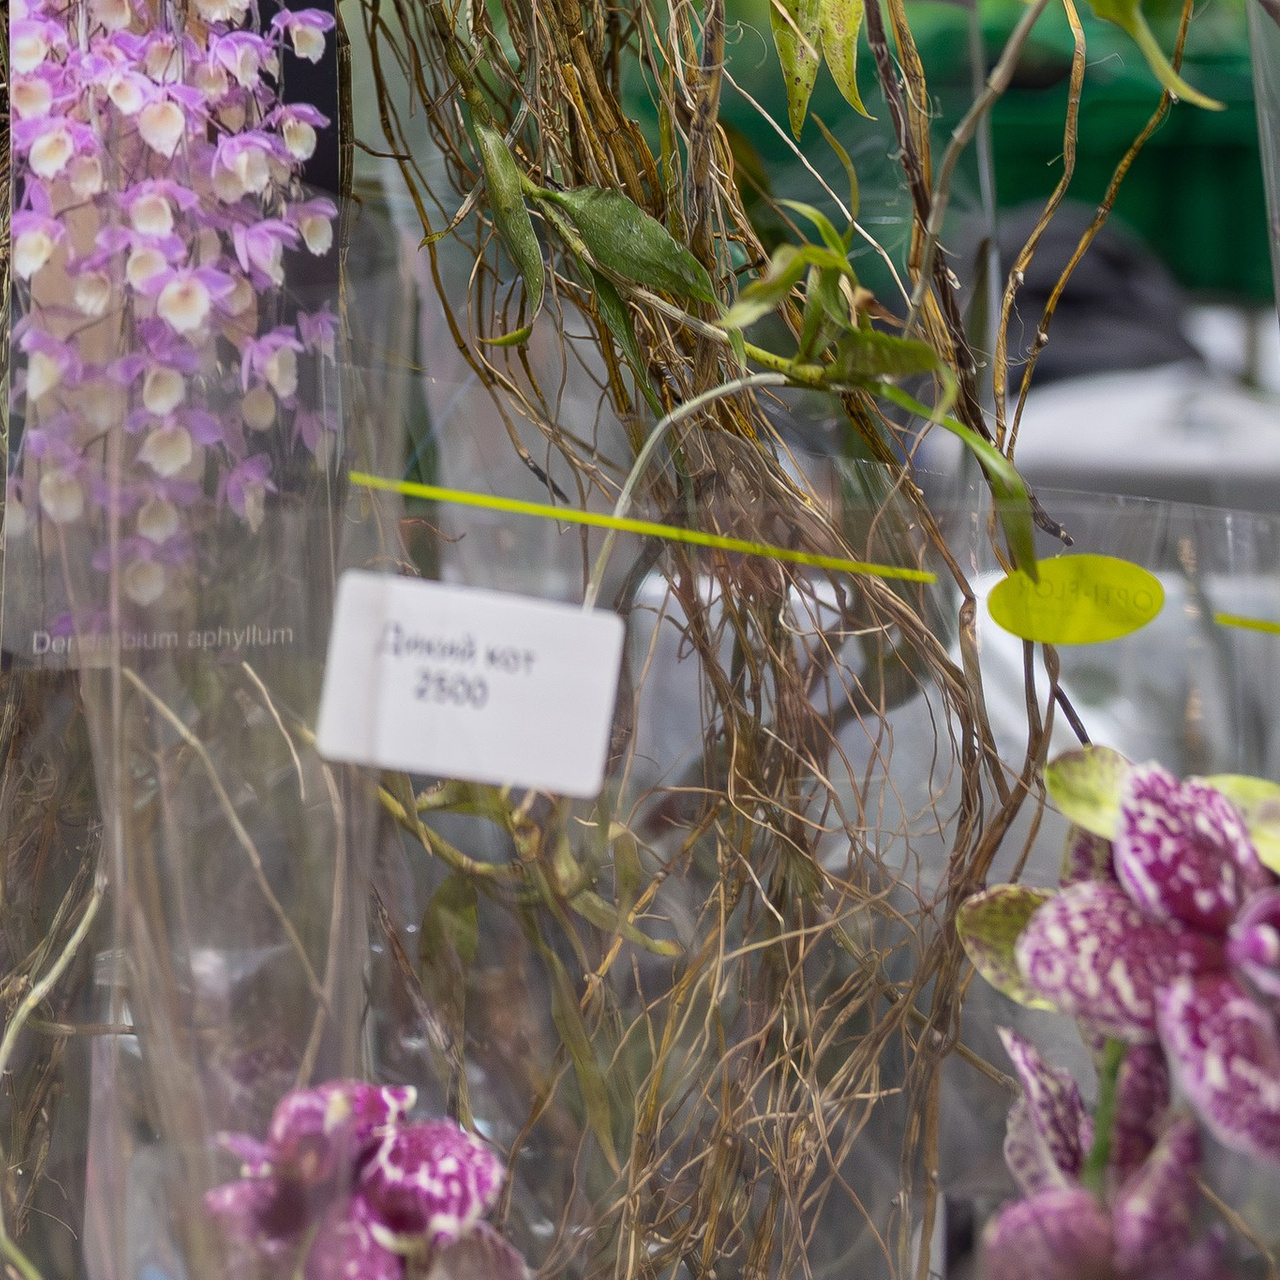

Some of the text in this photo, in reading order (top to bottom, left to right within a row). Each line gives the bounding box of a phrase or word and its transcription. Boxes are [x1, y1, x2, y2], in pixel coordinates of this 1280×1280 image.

[32, 624, 293, 656] Dendrbium aphyllum
[414, 664, 490, 710] 2500
